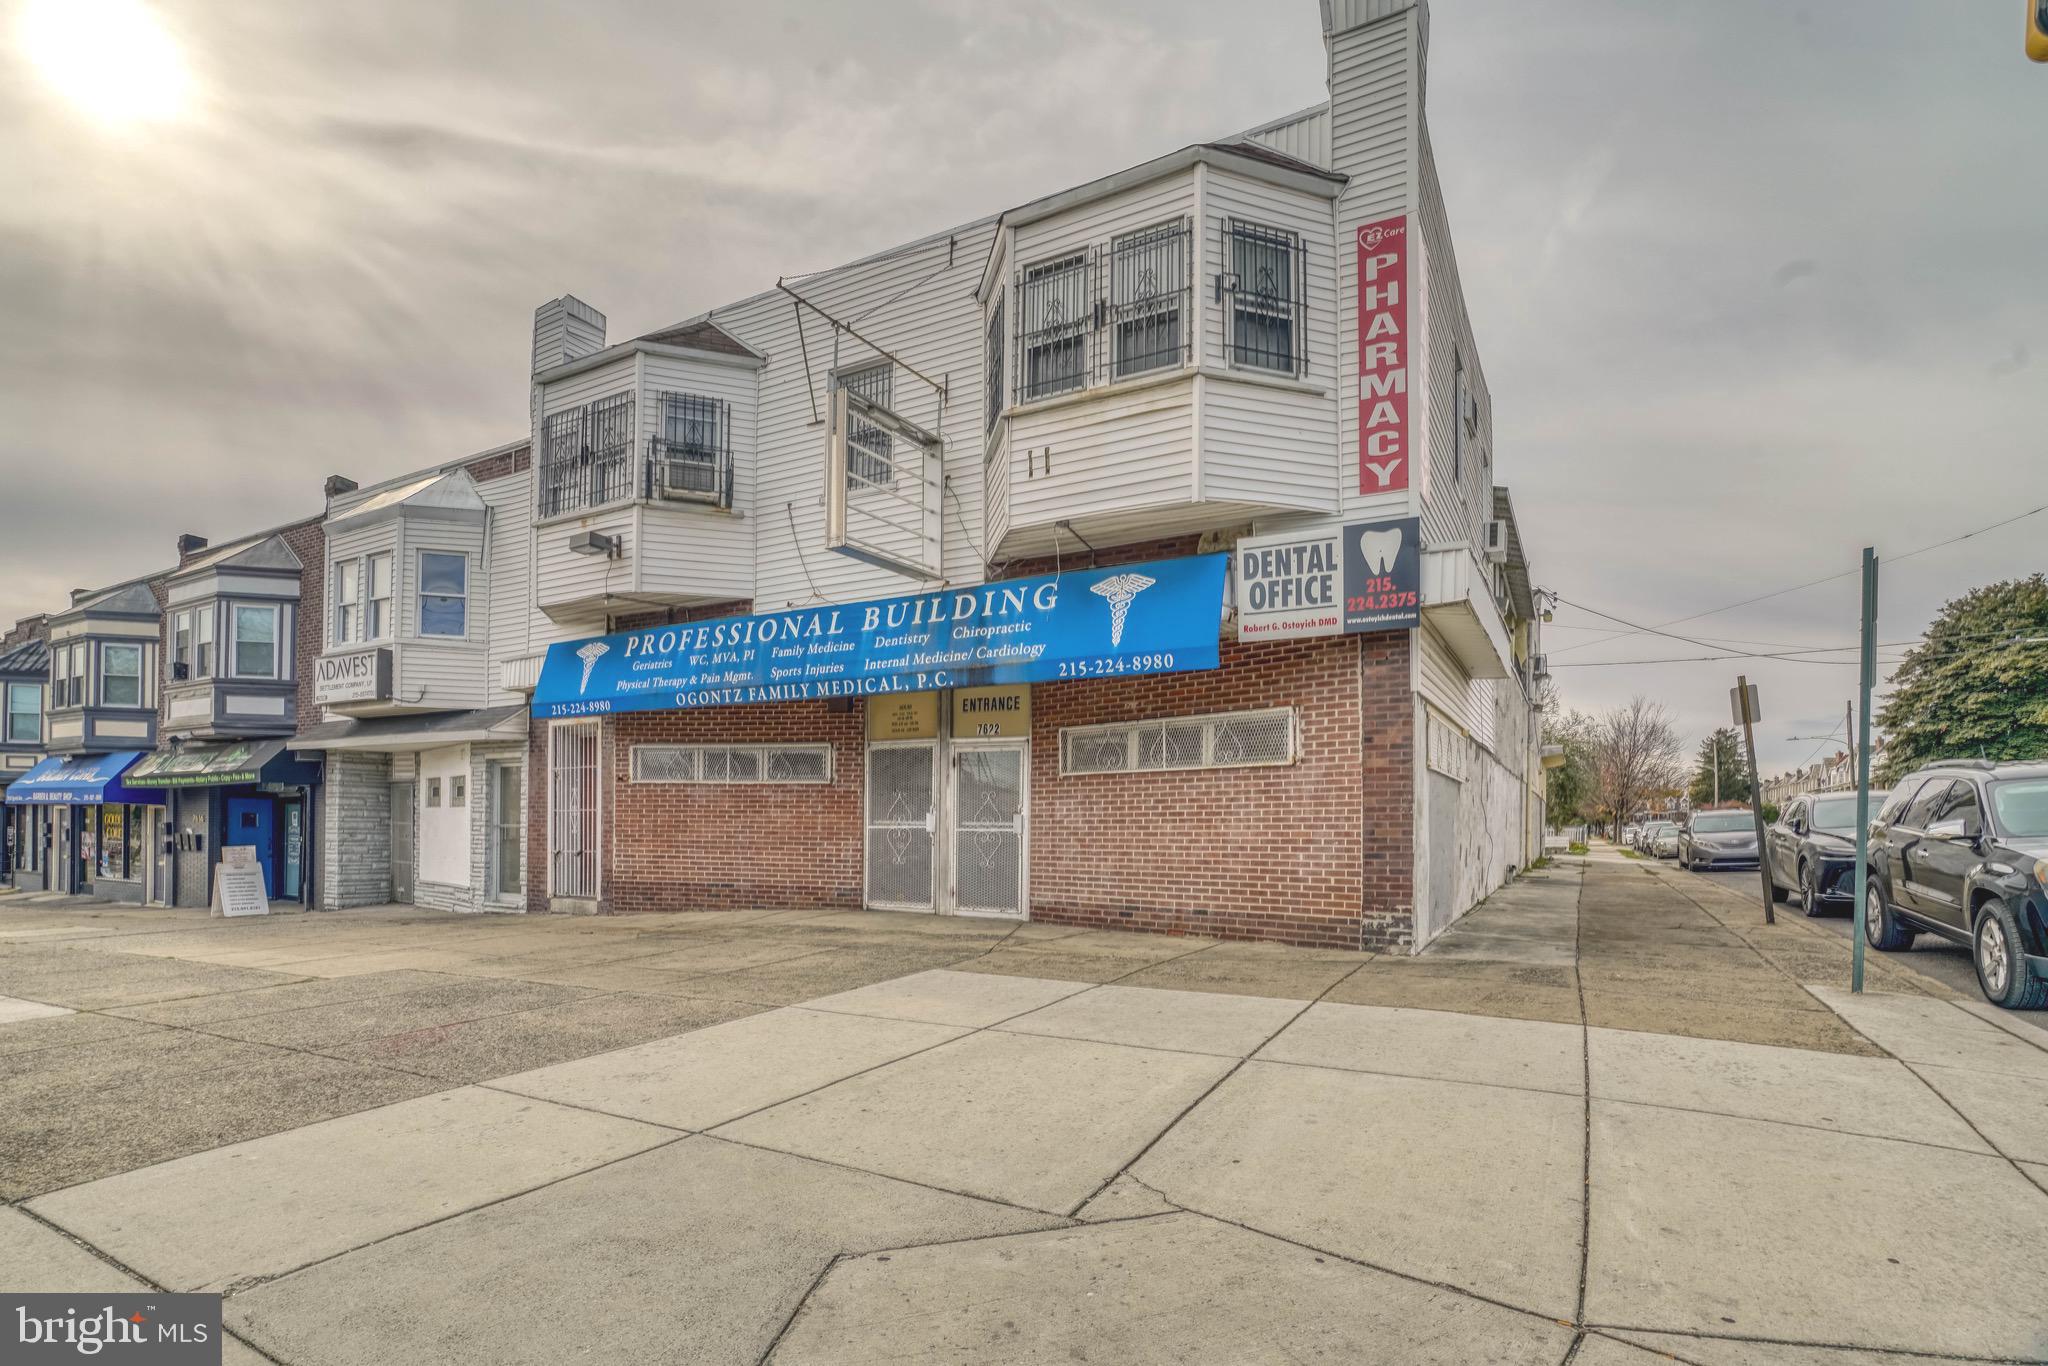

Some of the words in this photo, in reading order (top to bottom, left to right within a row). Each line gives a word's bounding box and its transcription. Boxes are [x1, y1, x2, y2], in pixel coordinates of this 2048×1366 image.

[1384, 226, 1405, 238] Care
[1360, 253, 1406, 487] PHARMACY
[1243, 543, 1337, 580] DENTAL
[1249, 575, 1333, 610] OFFICE
[1366, 576, 1396, 592] 215.
[1348, 592, 1417, 612] 224.2375
[624, 611, 844, 657] PROFESSIONAL
[862, 583, 1058, 631] BUILDING
[1244, 624, 1269, 633] Robert
[1282, 619, 1316, 631] Ostoyich
[1318, 617, 1337, 625] DMD
[953, 620, 1031, 640] Chiropractic
[874, 631, 930, 649] Dentistry
[690, 655, 709, 667] WC,
[712, 652, 740, 665] MVA,
[743, 650, 755, 661] PI
[772, 645, 804, 659] Family
[807, 641, 855, 655] Medicine
[864, 654, 910, 671] Internal
[977, 642, 1046, 661] Cardiology
[316, 654, 375, 682] ADAVEST
[632, 659, 673, 672] Geriatrics
[771, 666, 802, 678] Sports
[806, 662, 844, 675] Injuries
[1059, 653, 1174, 677] 215-224-8980
[616, 677, 650, 691] Physical
[652, 675, 687, 689] Therapy
[690, 676, 698, 684] &
[701, 673, 721, 683] Pain
[724, 672, 754, 686] Mgmt.
[676, 688, 743, 706] OGONTZ
[749, 684, 809, 702] FAMILY
[817, 675, 909, 696] MEDICAL,
[917, 671, 953, 689] P.C.
[551, 701, 611, 715] 215-224-8980
[962, 696, 1020, 712] ENTRANCE
[978, 724, 1000, 735] 7622
